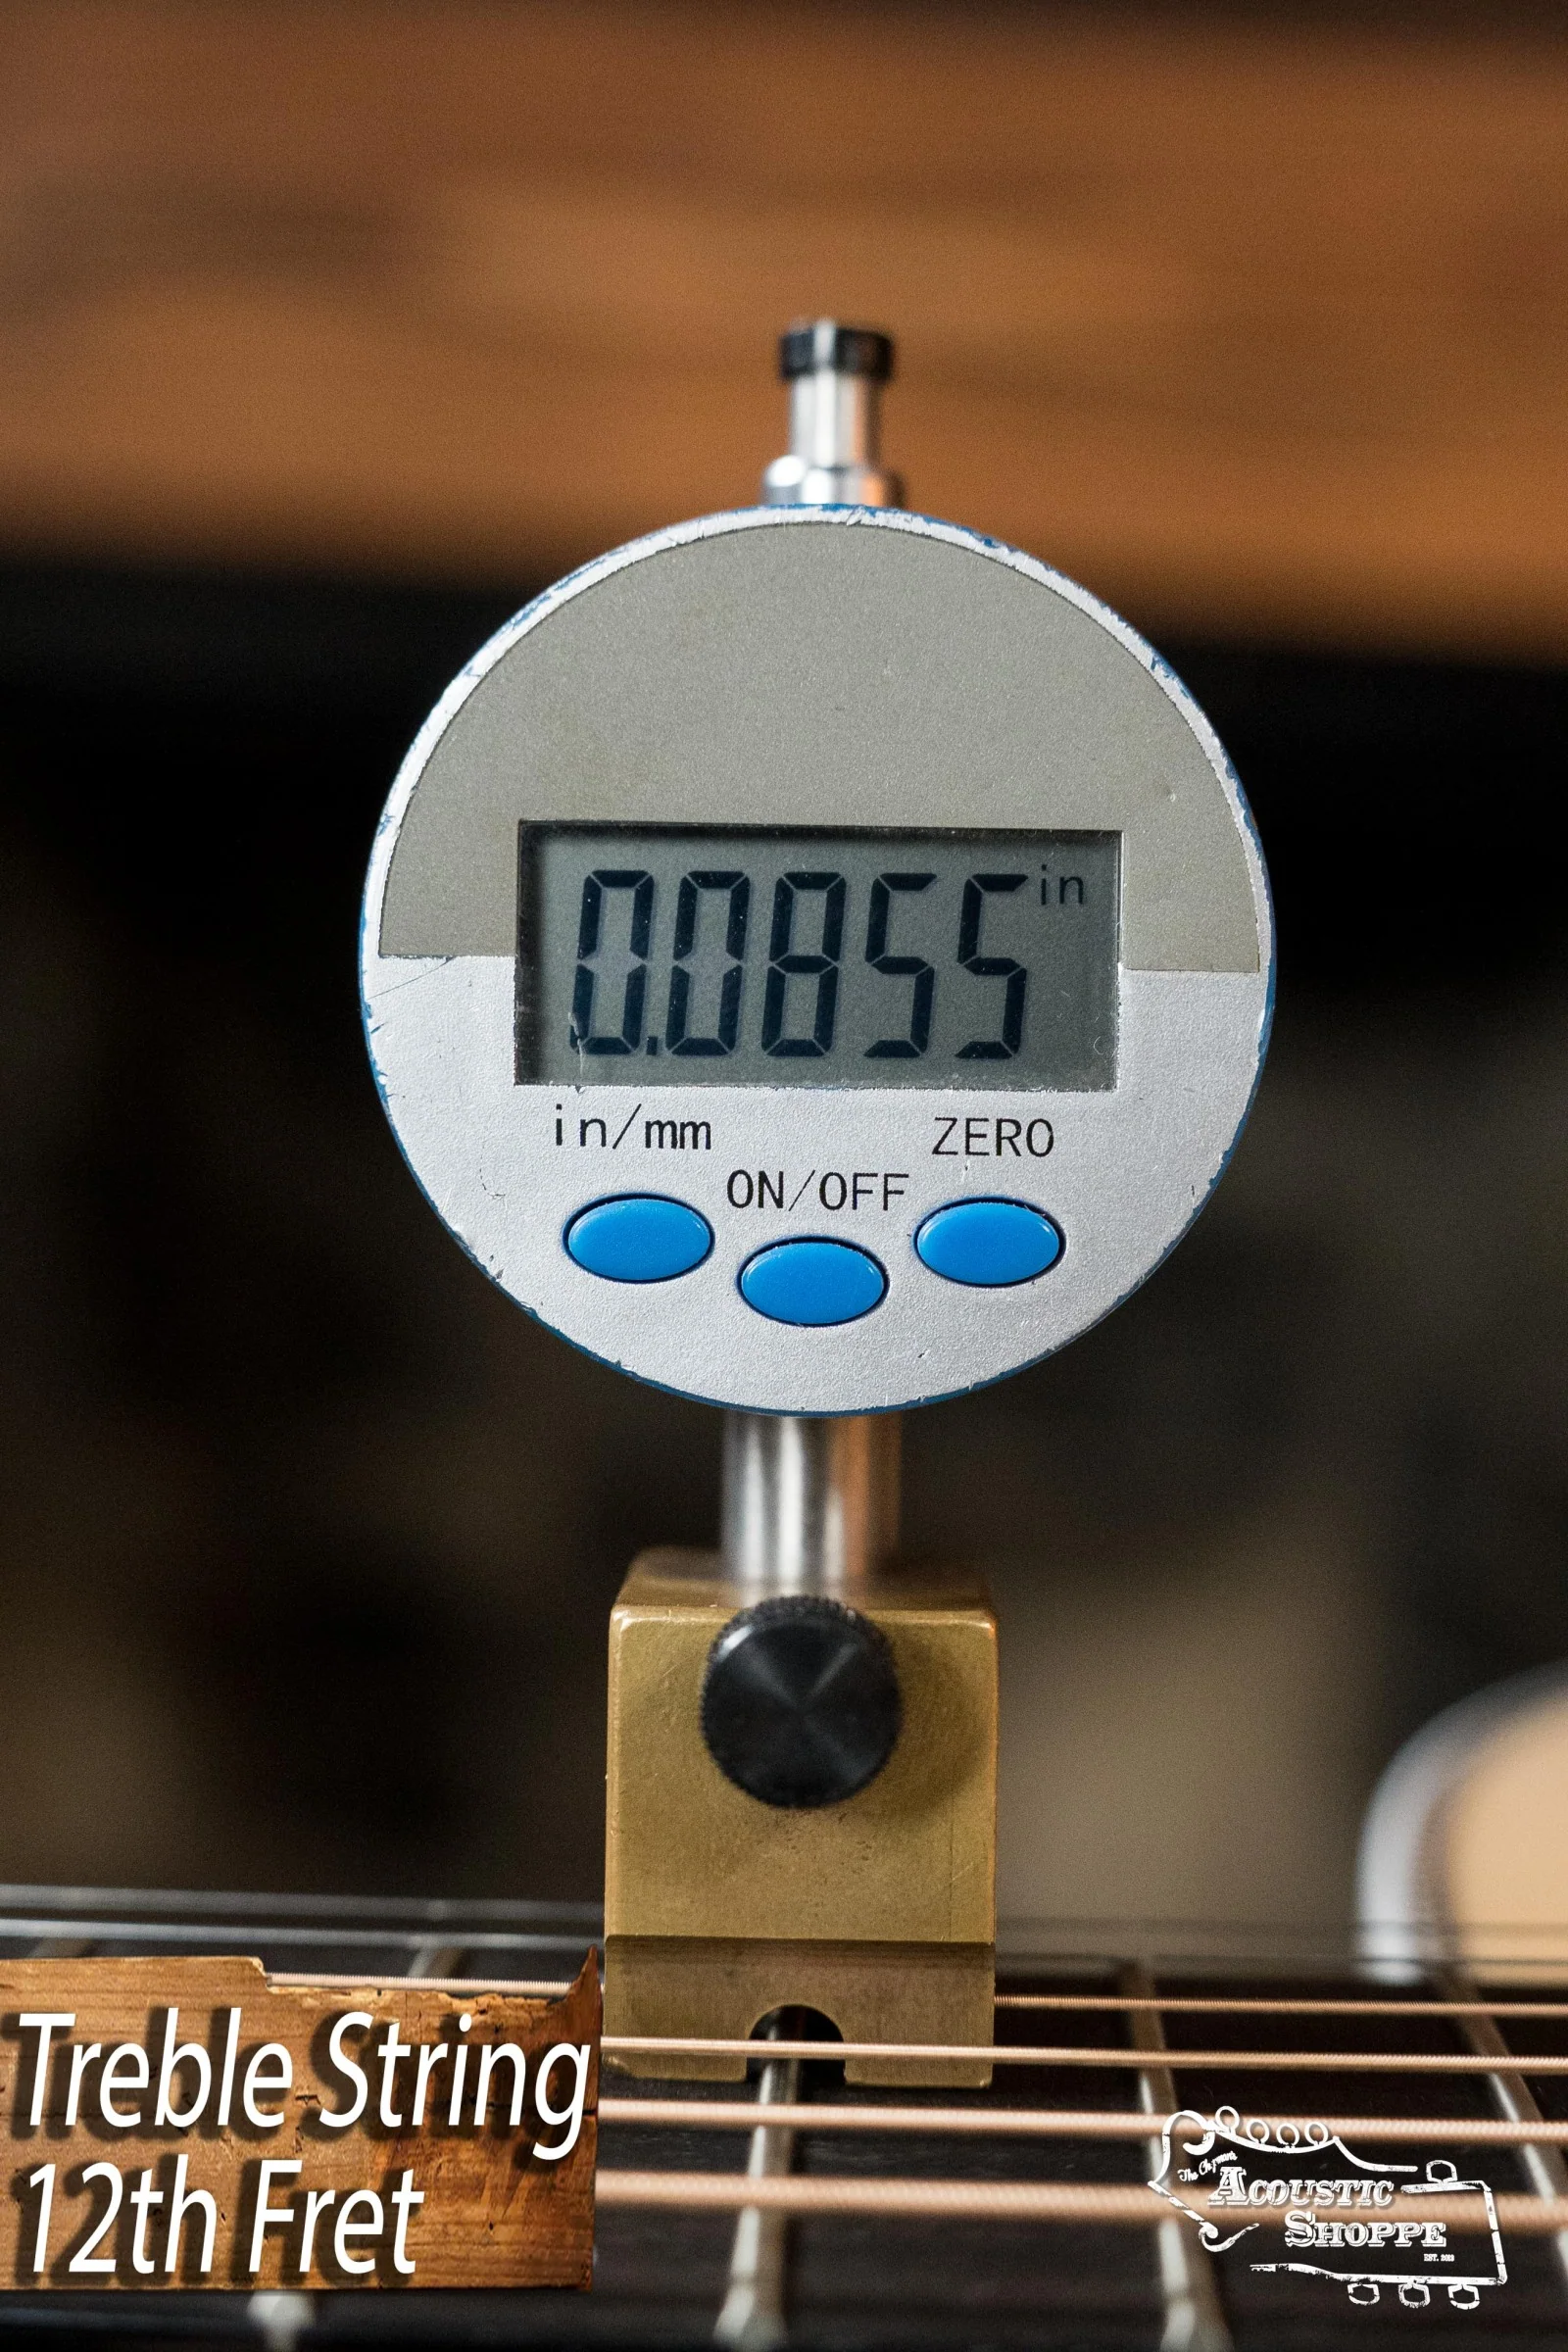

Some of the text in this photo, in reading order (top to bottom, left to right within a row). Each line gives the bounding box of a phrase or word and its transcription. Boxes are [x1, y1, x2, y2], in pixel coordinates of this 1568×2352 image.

[569, 863, 1085, 1059] 0.0855 in
[554, 1103, 712, 1151] in/mm
[931, 1116, 1055, 1157] ZERO
[726, 1169, 909, 1213] ON/OFF
